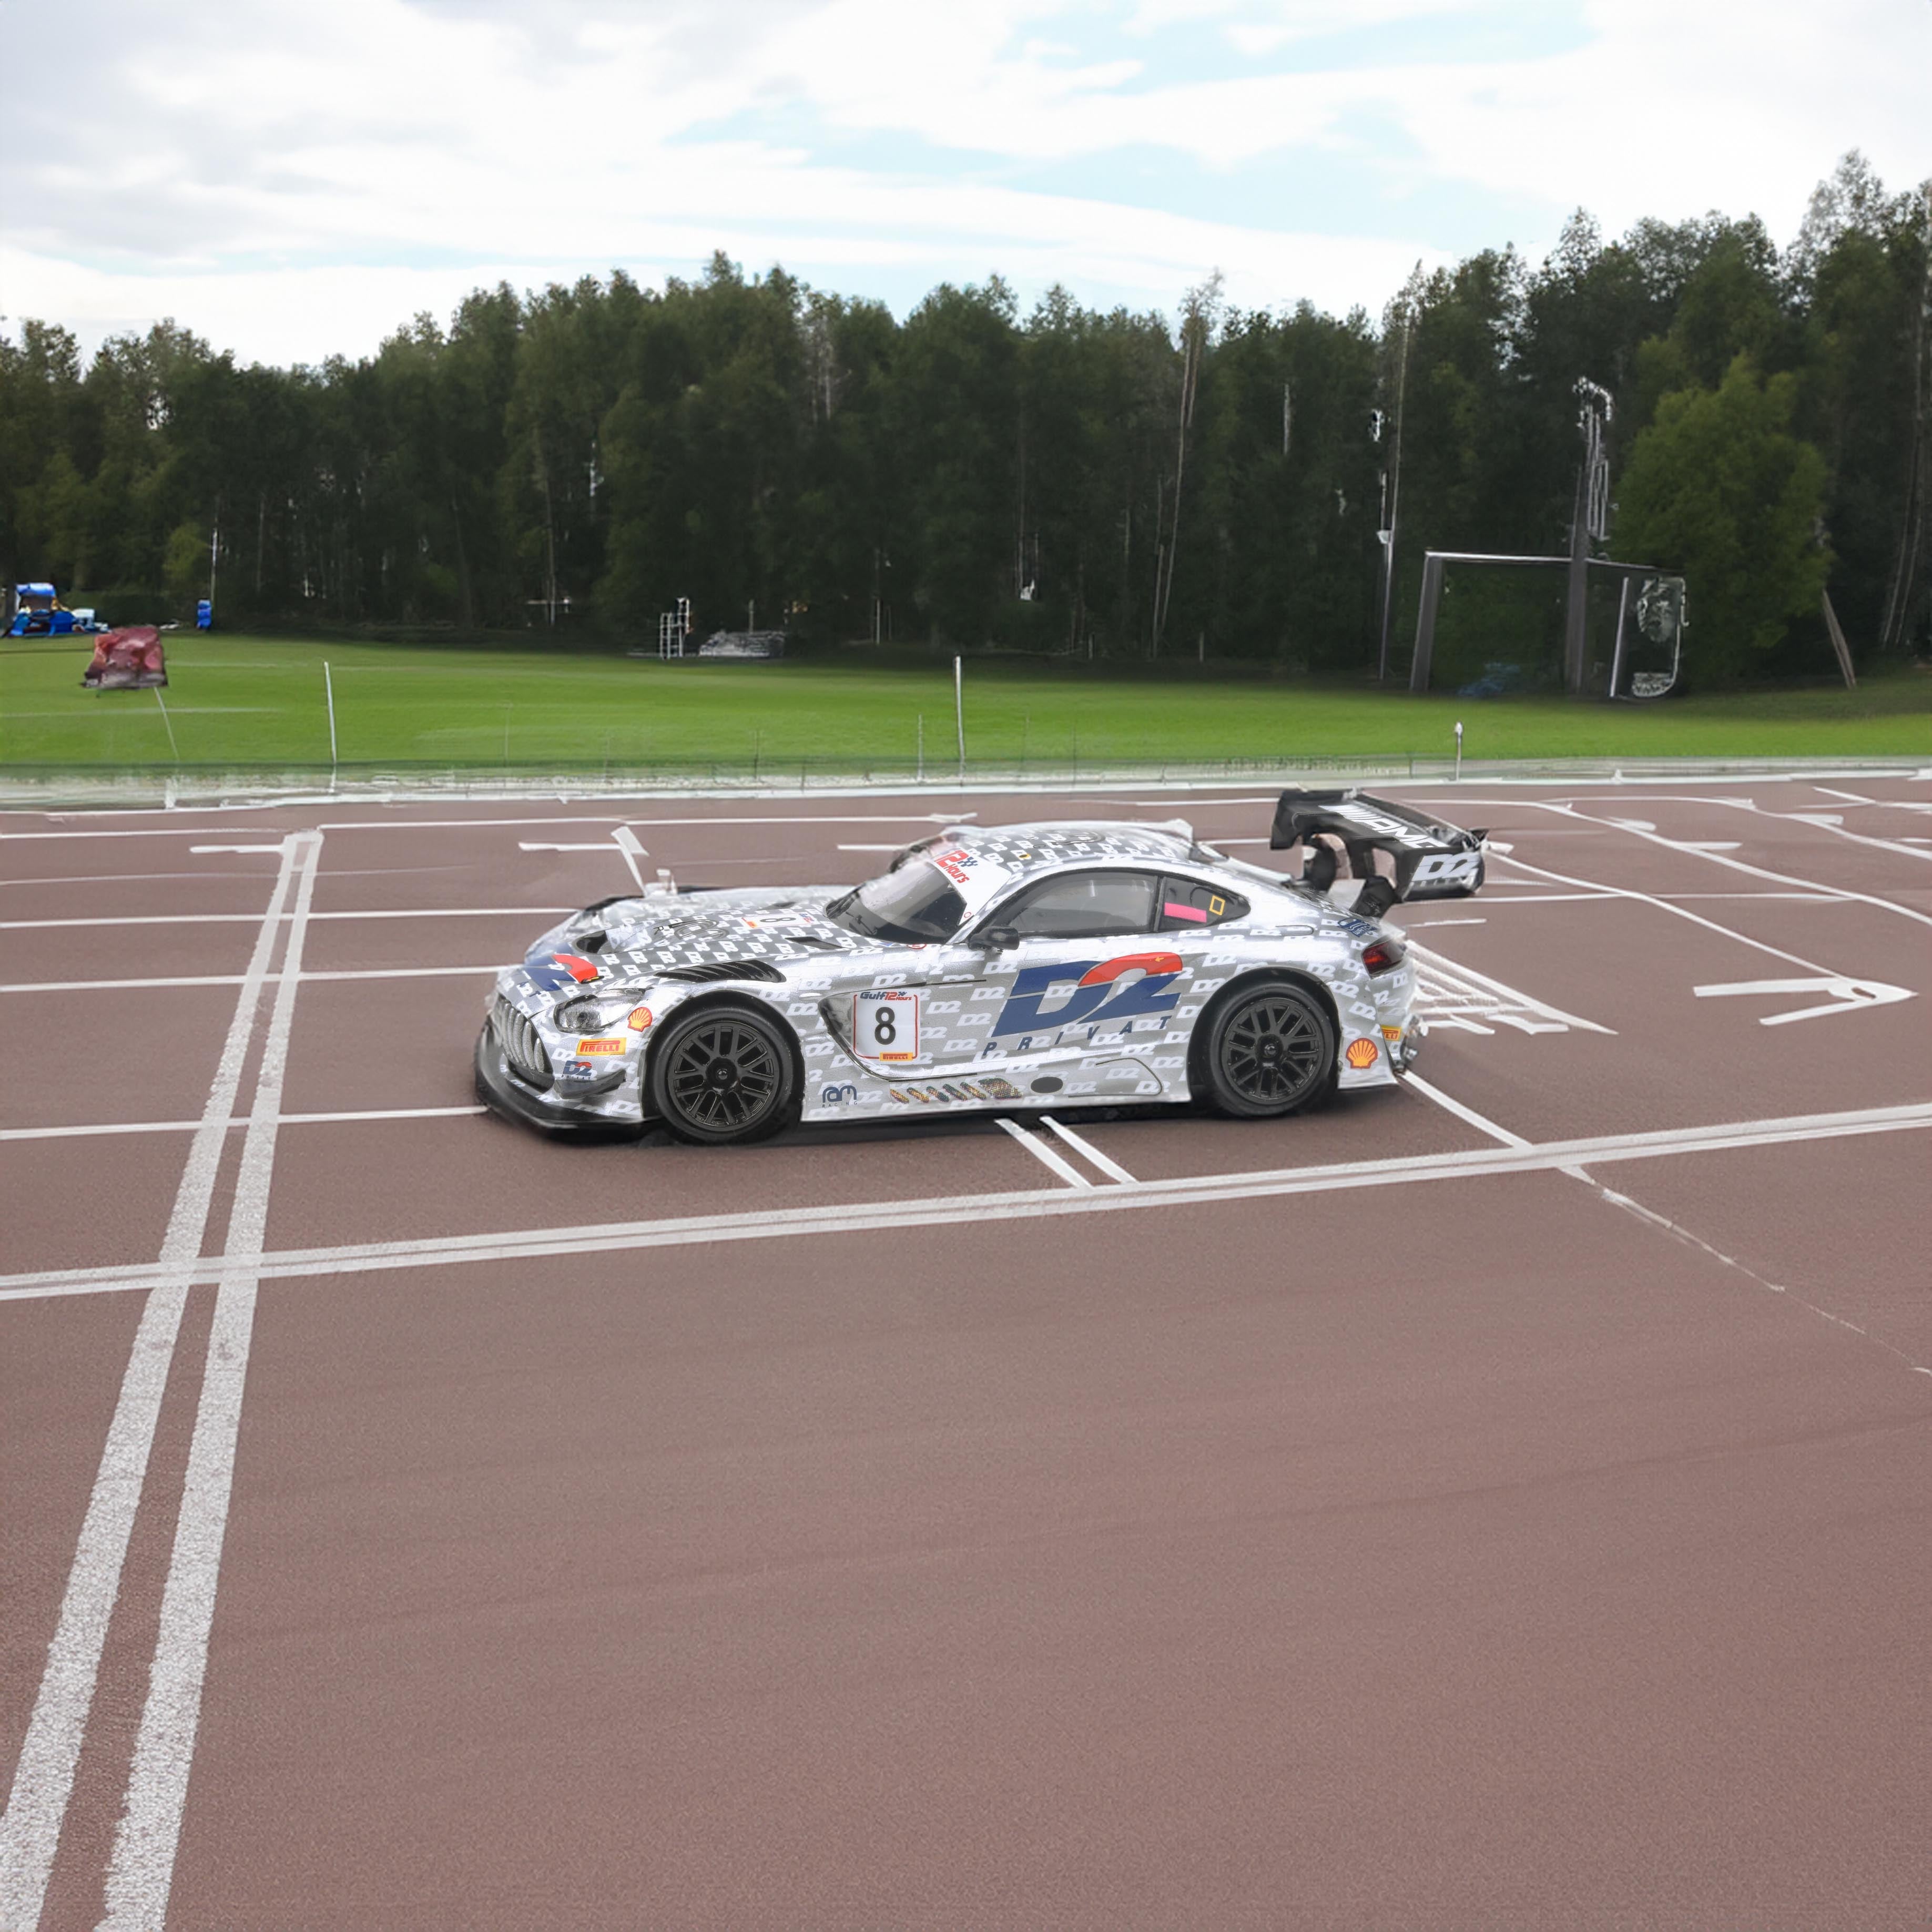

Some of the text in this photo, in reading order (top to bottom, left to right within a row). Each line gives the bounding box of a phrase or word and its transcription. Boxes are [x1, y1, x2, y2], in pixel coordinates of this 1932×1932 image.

[934, 850, 969, 868] 12
[943, 864, 970, 883] Hours
[1412, 852, 1479, 881] D2
[982, 961, 1018, 974] D2
[1202, 954, 1237, 967] D2
[871, 973, 907, 988] D2
[970, 987, 1005, 1001] D2
[991, 952, 1183, 1038] D2
[1044, 984, 1077, 998] D2
[1330, 981, 1359, 999] D2
[786, 1003, 818, 1015] D2
[926, 1001, 961, 1014] D2
[1348, 1001, 1376, 1021] D2
[875, 1006, 896, 1045] 8
[957, 1013, 992, 1026] D2
[983, 1015, 1172, 1056] PRIVAT
[1090, 1032, 1125, 1046] D2
[580, 1040, 621, 1052] PIRELLI
[805, 1042, 835, 1057] D2
[943, 1039, 978, 1052] D2
[563, 1060, 593, 1076] D2
[1152, 1056, 1184, 1069] D2
[1105, 1068, 1140, 1080] D2
[1063, 1081, 1097, 1094] D2
